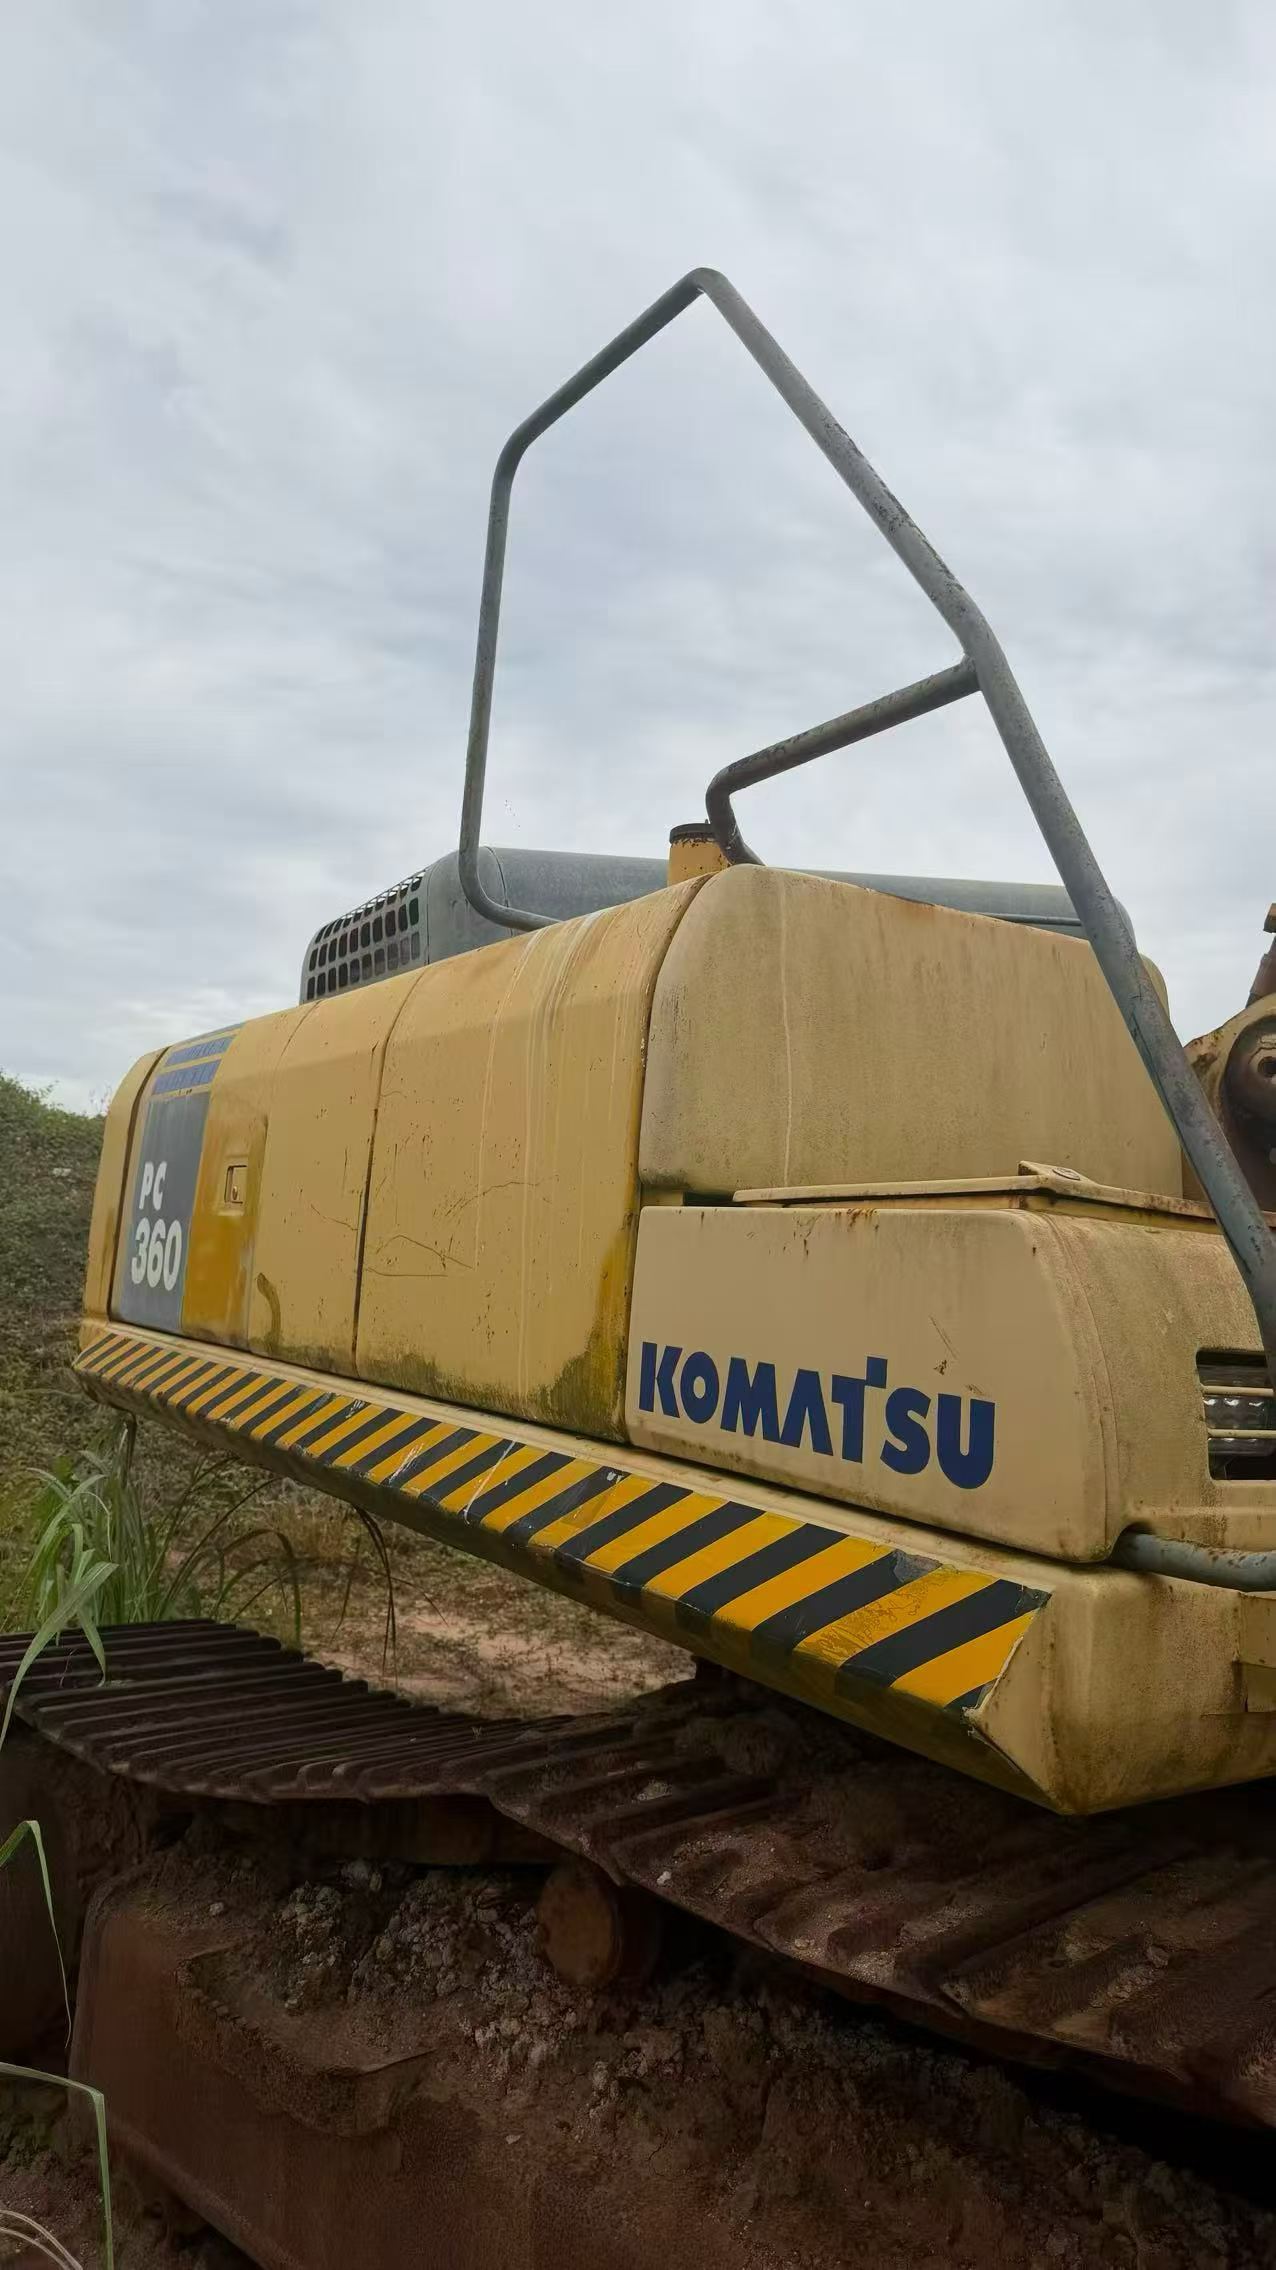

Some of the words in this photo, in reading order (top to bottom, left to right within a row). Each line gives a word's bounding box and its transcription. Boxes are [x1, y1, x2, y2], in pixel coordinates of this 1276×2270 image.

[138, 1160, 168, 1211] PC
[131, 1217, 183, 1292] 360
[638, 1341, 996, 1490] KOMATSU
